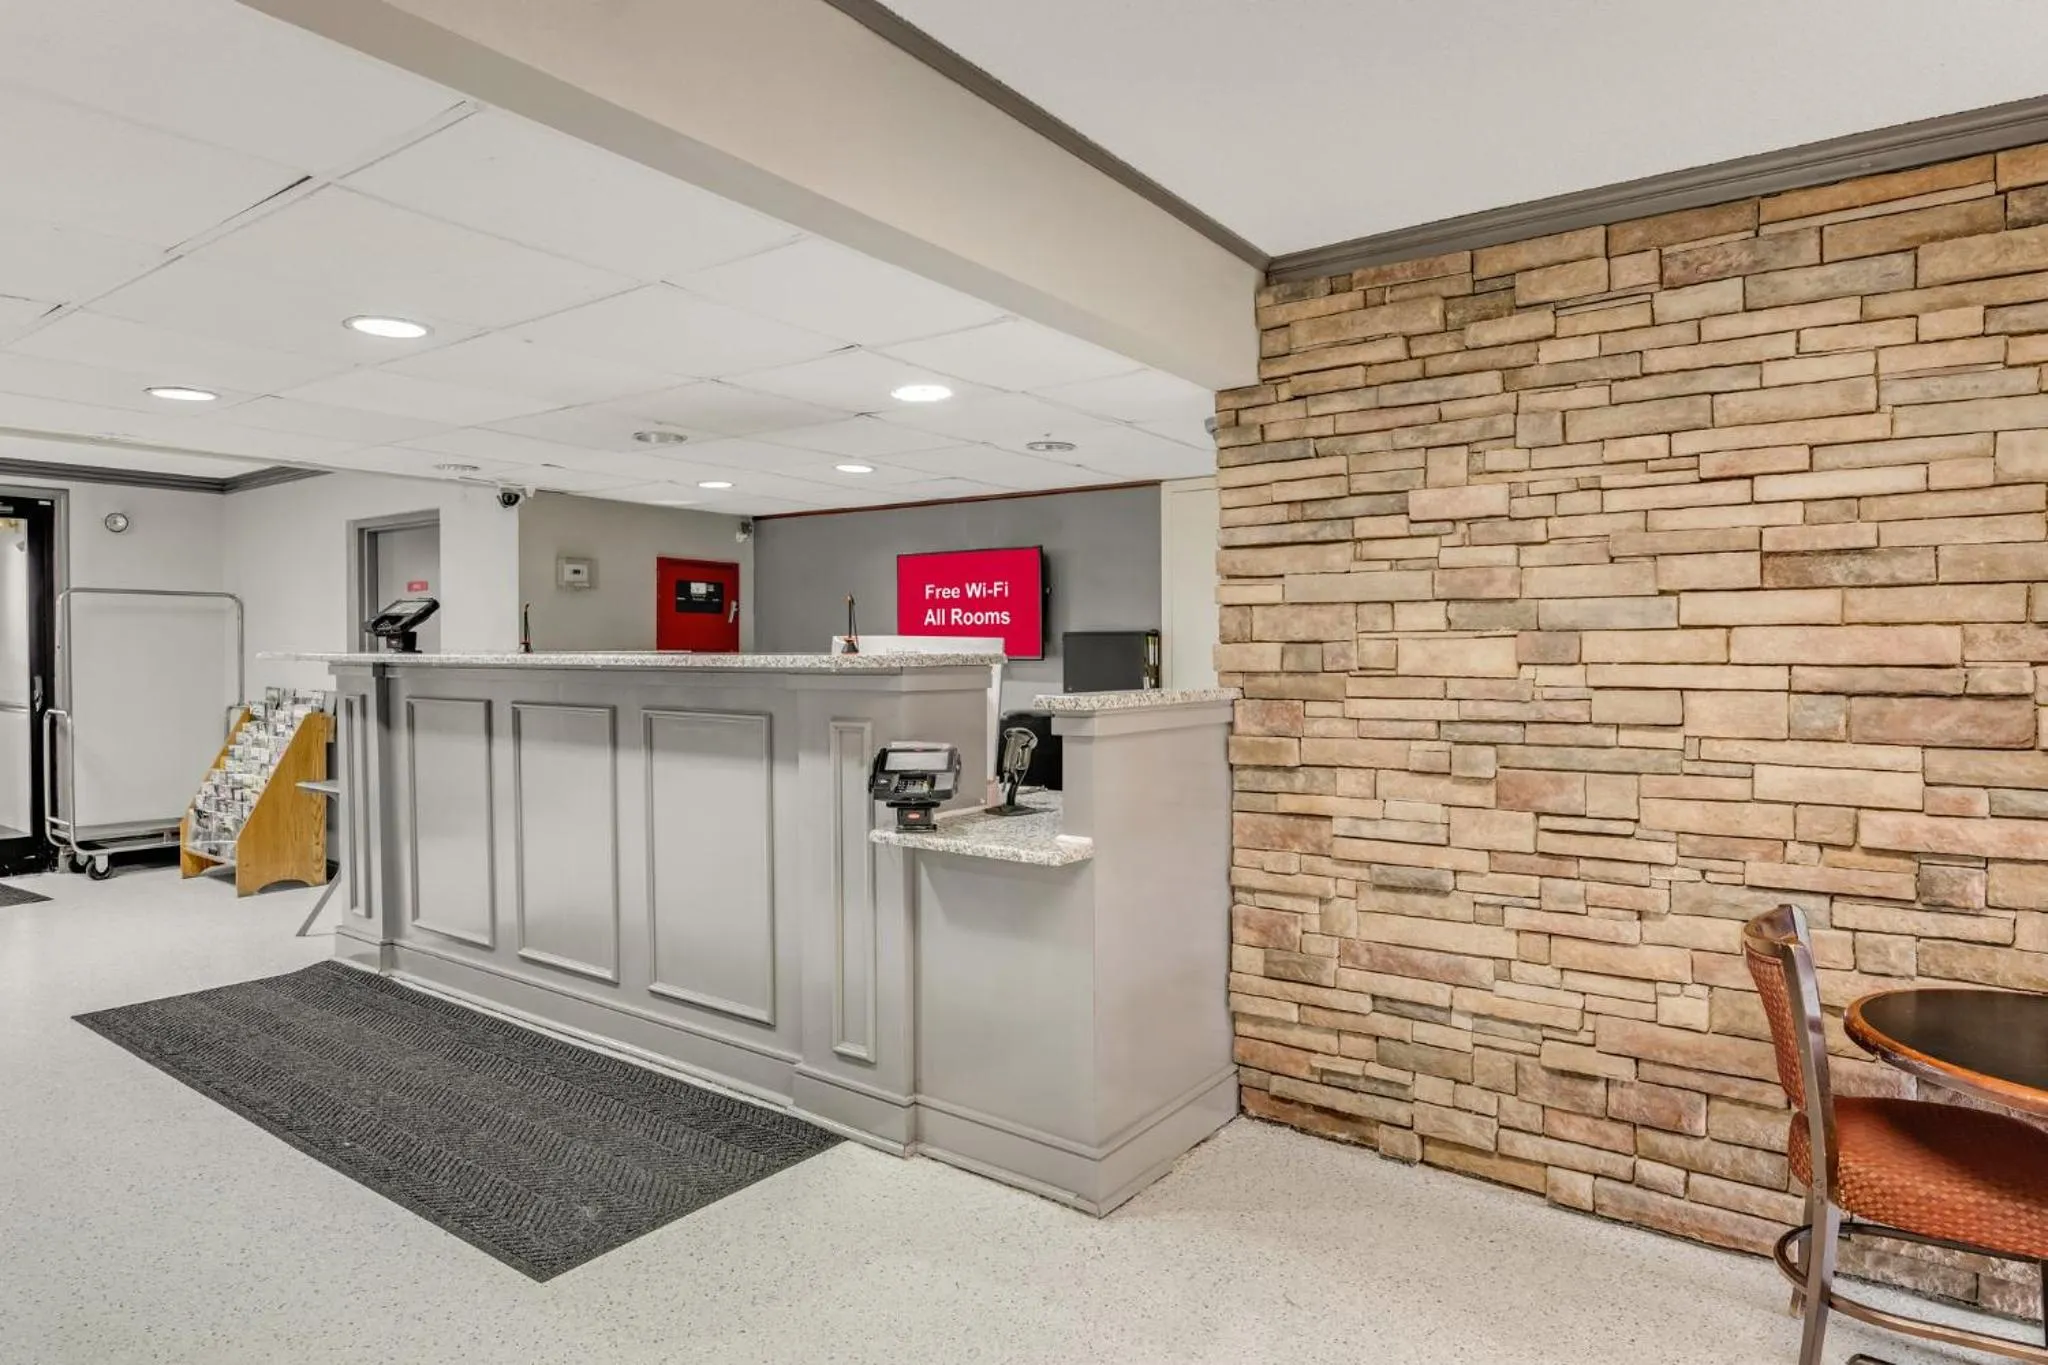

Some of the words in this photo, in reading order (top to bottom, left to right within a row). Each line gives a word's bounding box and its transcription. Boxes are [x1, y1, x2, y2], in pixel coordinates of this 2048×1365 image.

[925, 584, 960, 599] Free
[965, 581, 1009, 599] Wi-Fi
[924, 608, 945, 625] All
[951, 608, 1011, 625] Rooms
